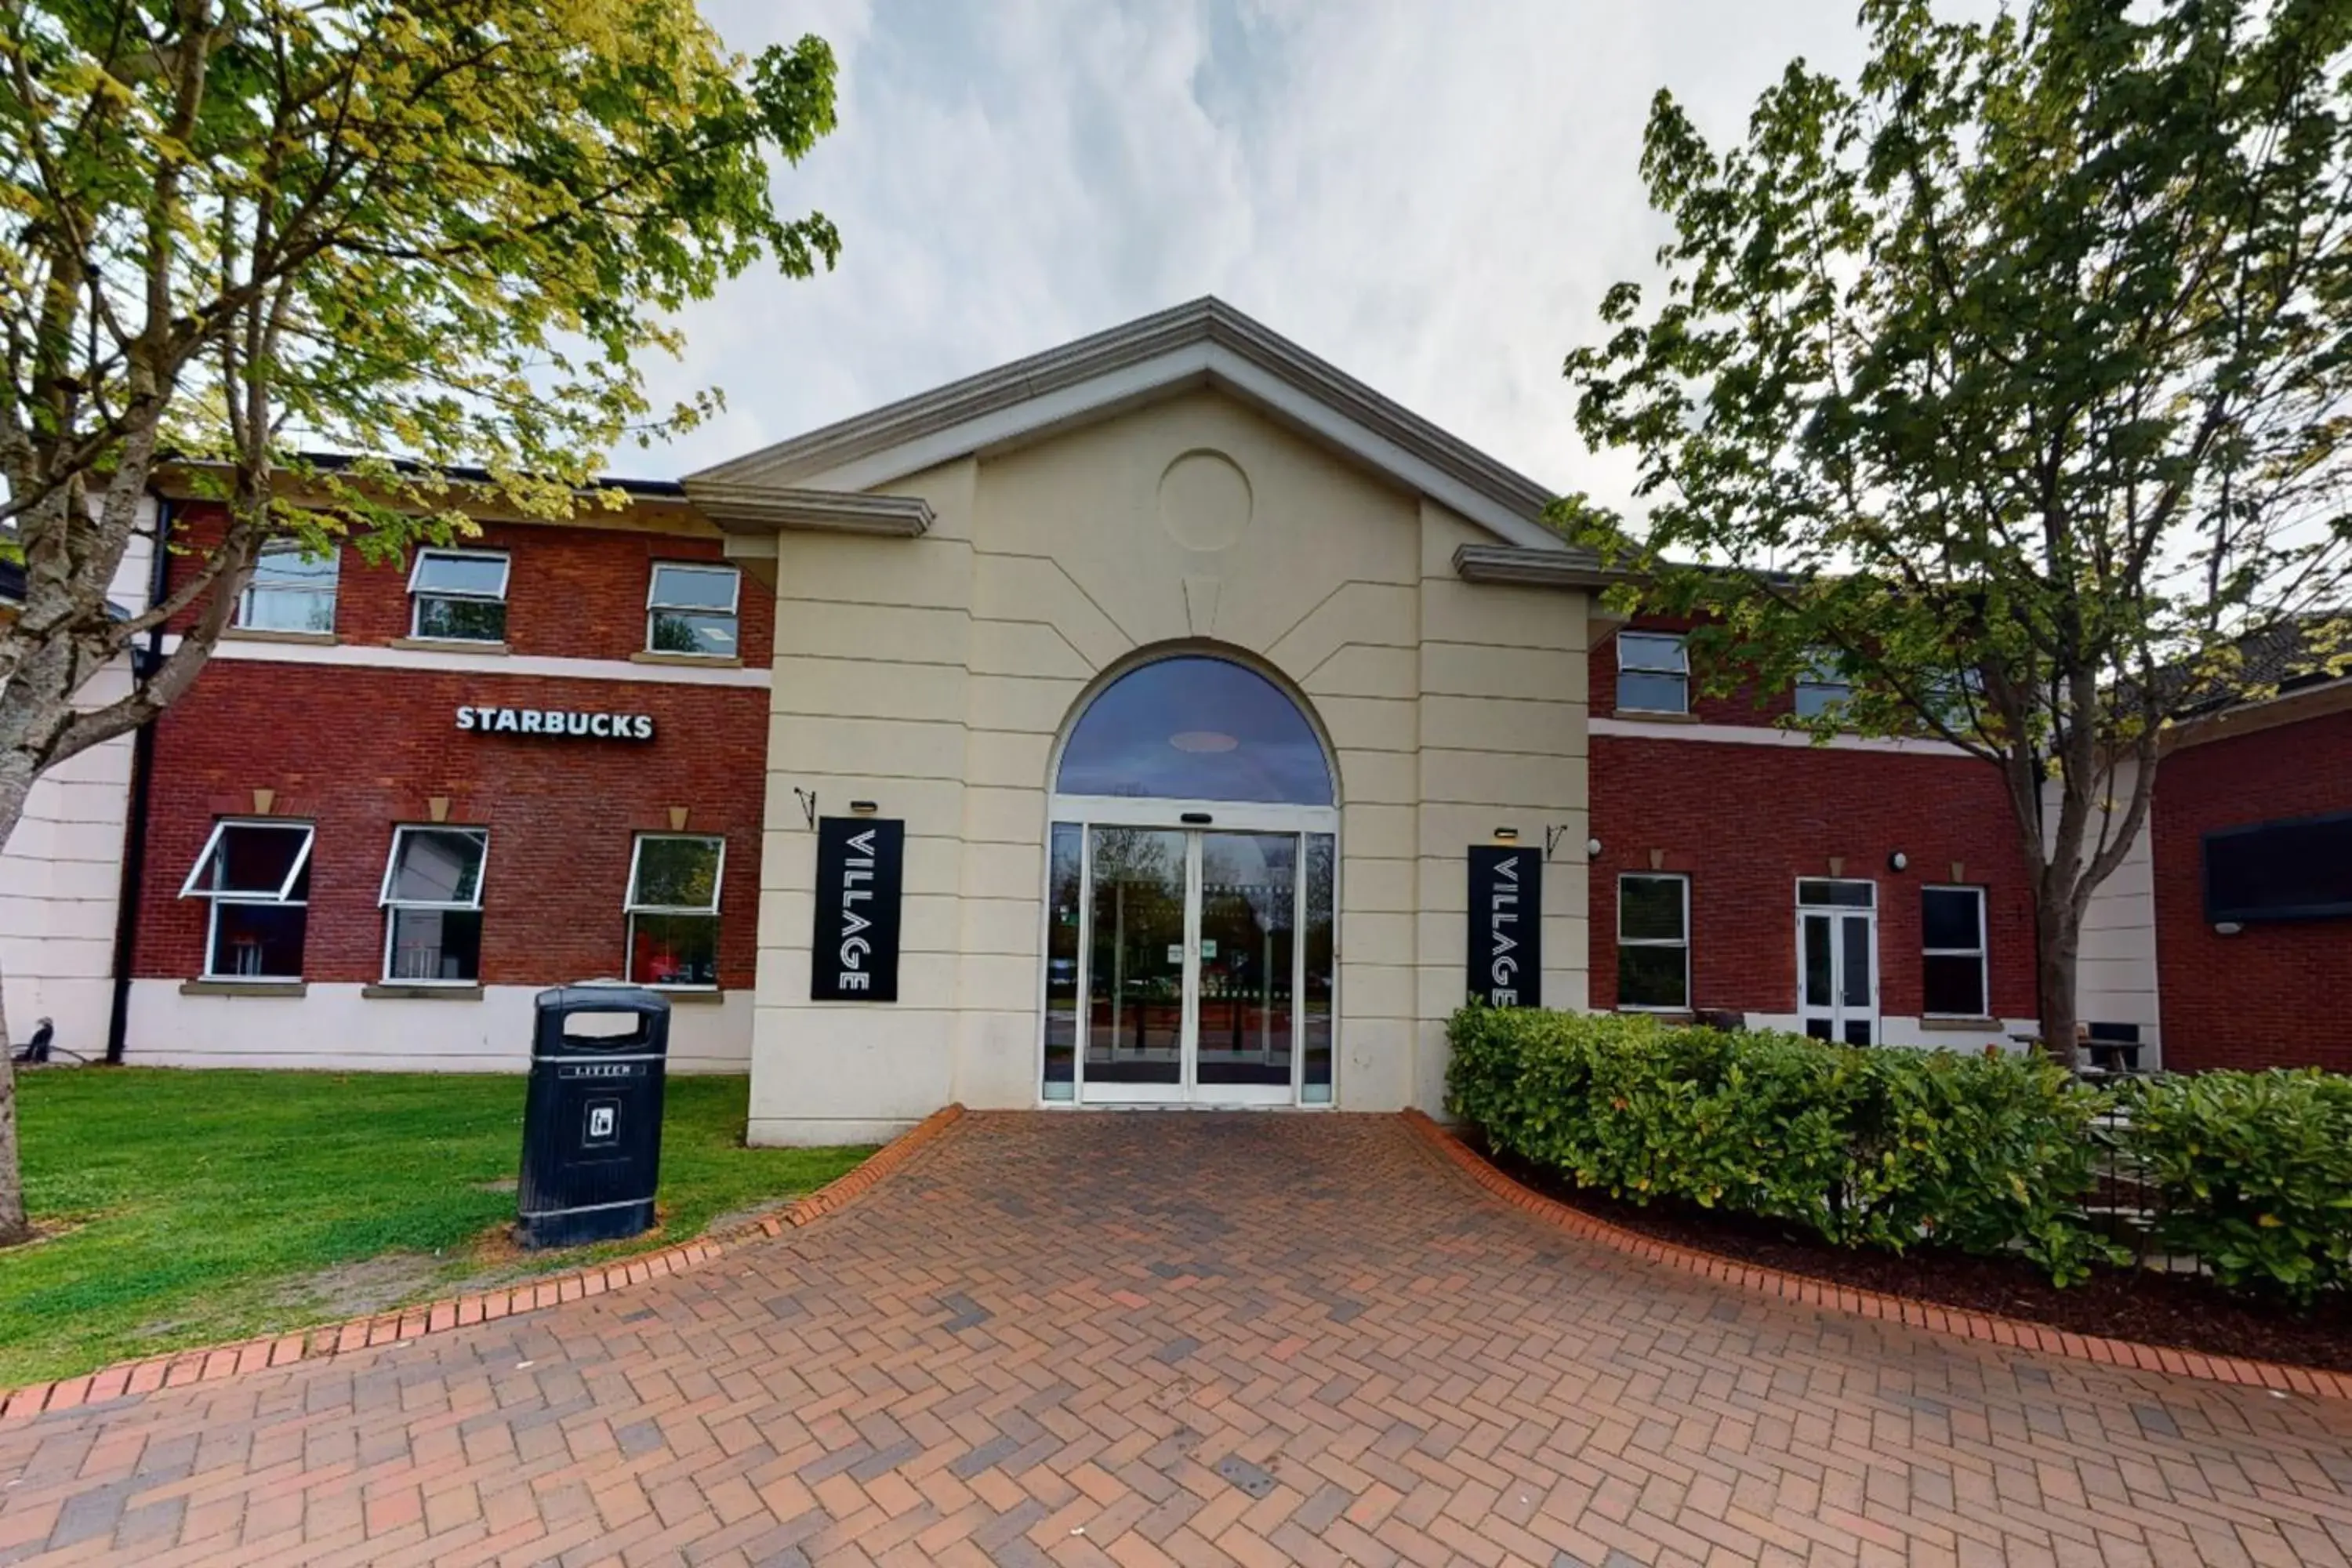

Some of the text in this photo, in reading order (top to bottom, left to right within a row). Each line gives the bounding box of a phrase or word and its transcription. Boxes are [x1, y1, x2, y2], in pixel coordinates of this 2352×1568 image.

[456, 706, 653, 739] STARBUCKS
[838, 829, 877, 991] VILLAGE
[1491, 856, 1519, 1007] VILLAGE
